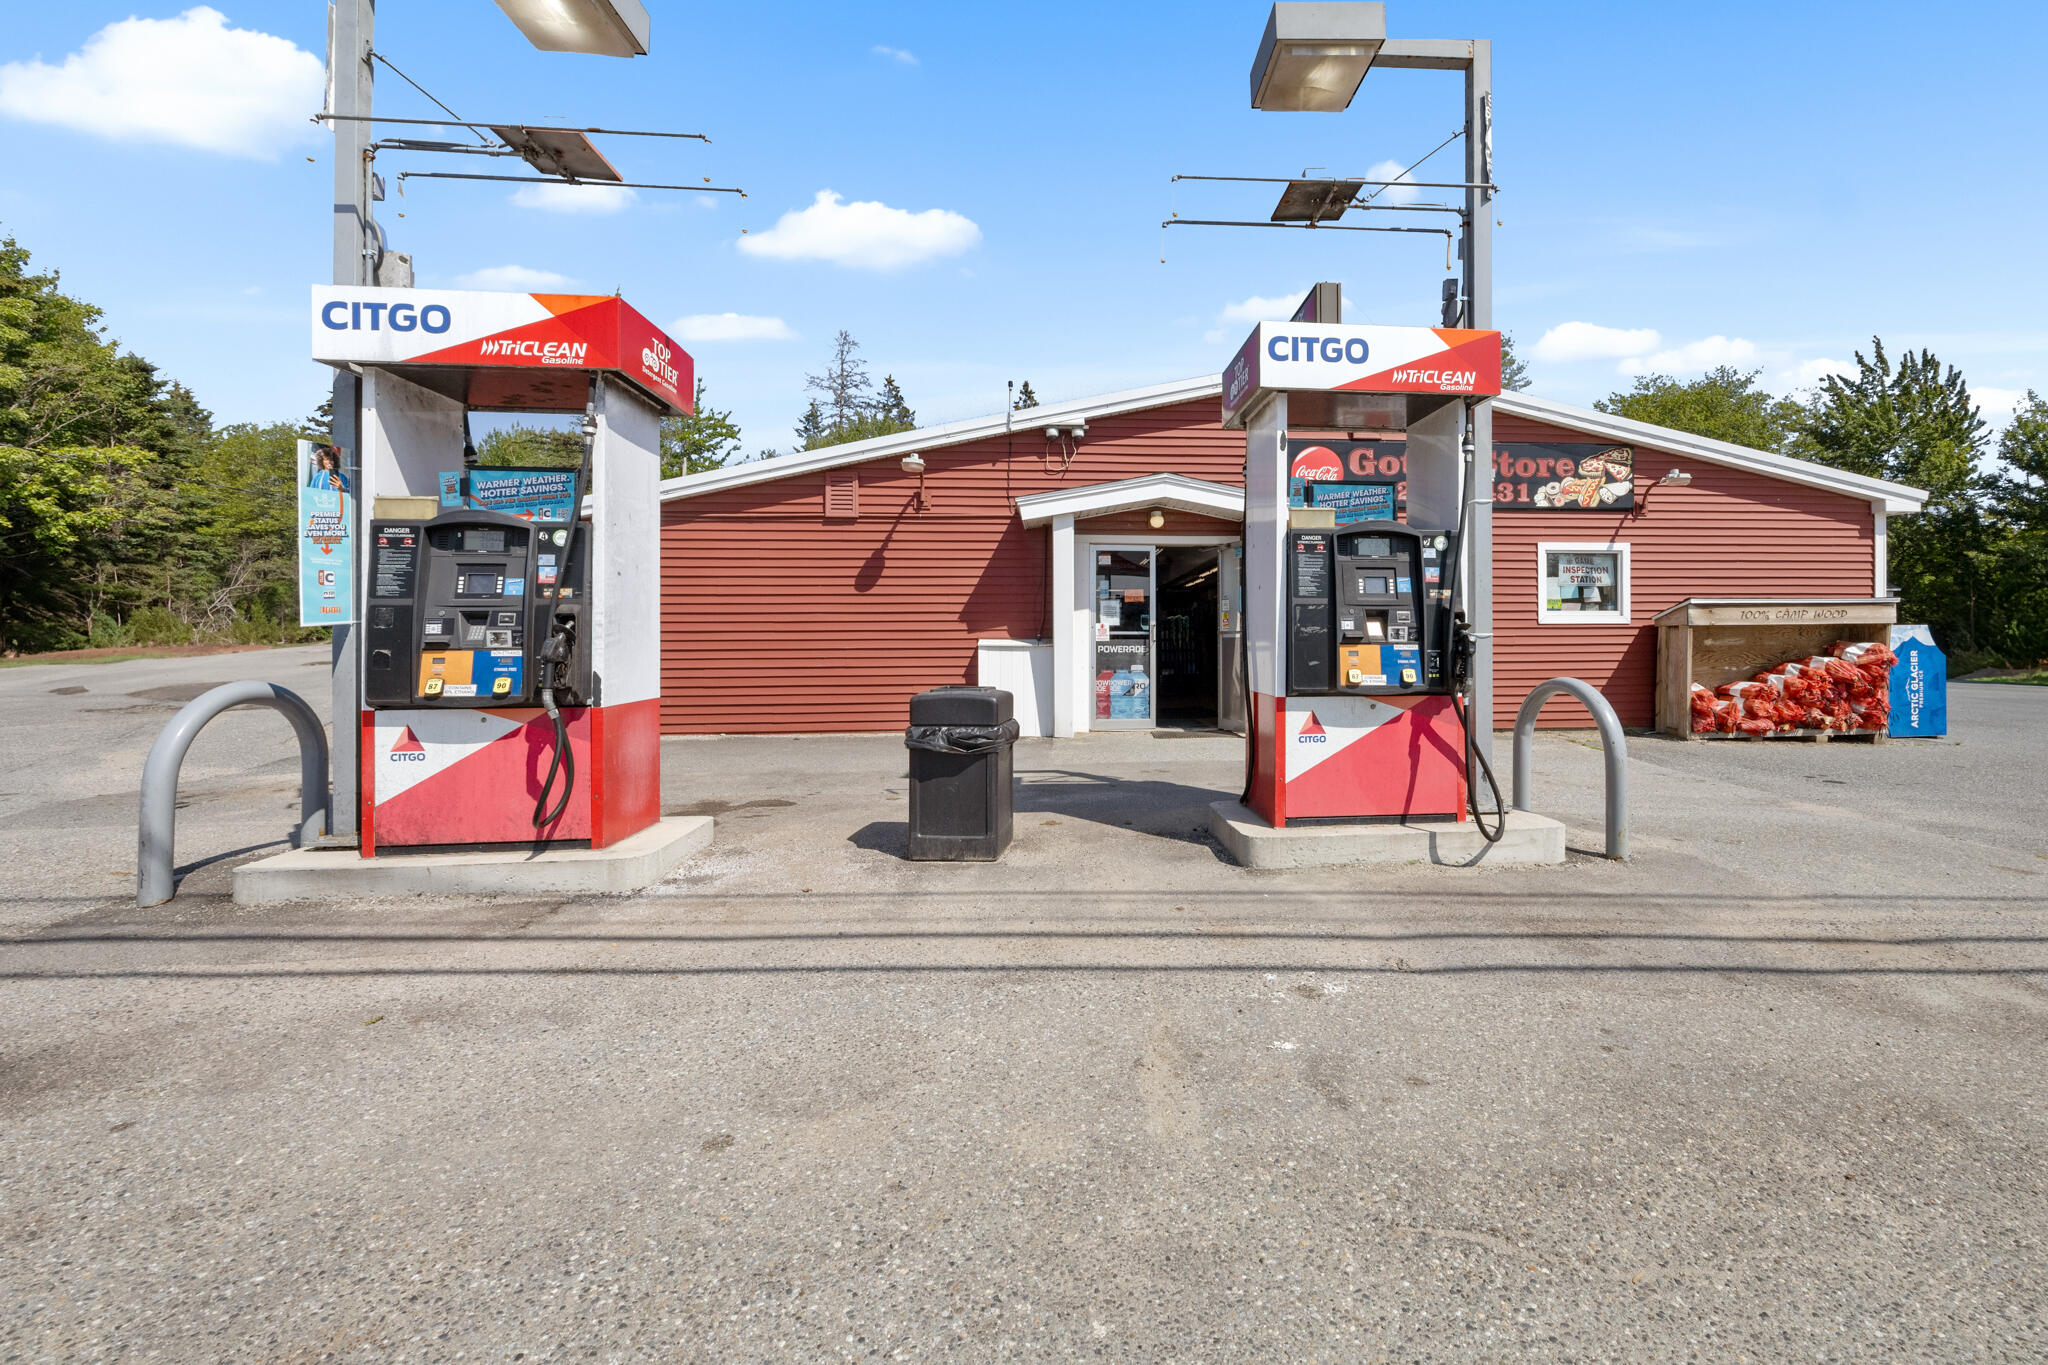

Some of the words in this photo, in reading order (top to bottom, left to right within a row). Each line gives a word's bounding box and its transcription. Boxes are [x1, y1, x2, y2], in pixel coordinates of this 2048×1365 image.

[321, 300, 451, 335] CITGO
[500, 340, 588, 359] TriCLEAN
[652, 337, 671, 363] TOP
[1267, 335, 1370, 365] CITGO
[541, 355, 584, 366] Gasoline
[659, 359, 678, 387] TIER
[1407, 369, 1476, 386] TriCLEAN
[1440, 383, 1474, 393] Gasoline
[1491, 449, 1576, 478] tore
[1294, 464, 1338, 481] Coca-Cola
[476, 478, 521, 491] WARMER
[522, 473, 571, 487] WEATHER.
[480, 487, 519, 499] HOTTER
[520, 483, 567, 496] SAVINGS.
[1316, 491, 1351, 503] WARMER
[1352, 487, 1390, 498] WEATHER.
[1350, 495, 1387, 506] SAVINGS.
[1562, 566, 1609, 574] INSPECTION
[1570, 575, 1603, 584] STATION
[1740, 609, 1771, 621] 100%
[1775, 608, 1809, 620] CAMP
[1813, 609, 1849, 620] WOOD
[1097, 645, 1148, 654] POWERADE
[1910, 649, 1919, 691] GLACIER
[1910, 693, 1919, 729] ARCTIC
[1298, 735, 1327, 744] CITGO
[390, 752, 426, 762] CITGO
